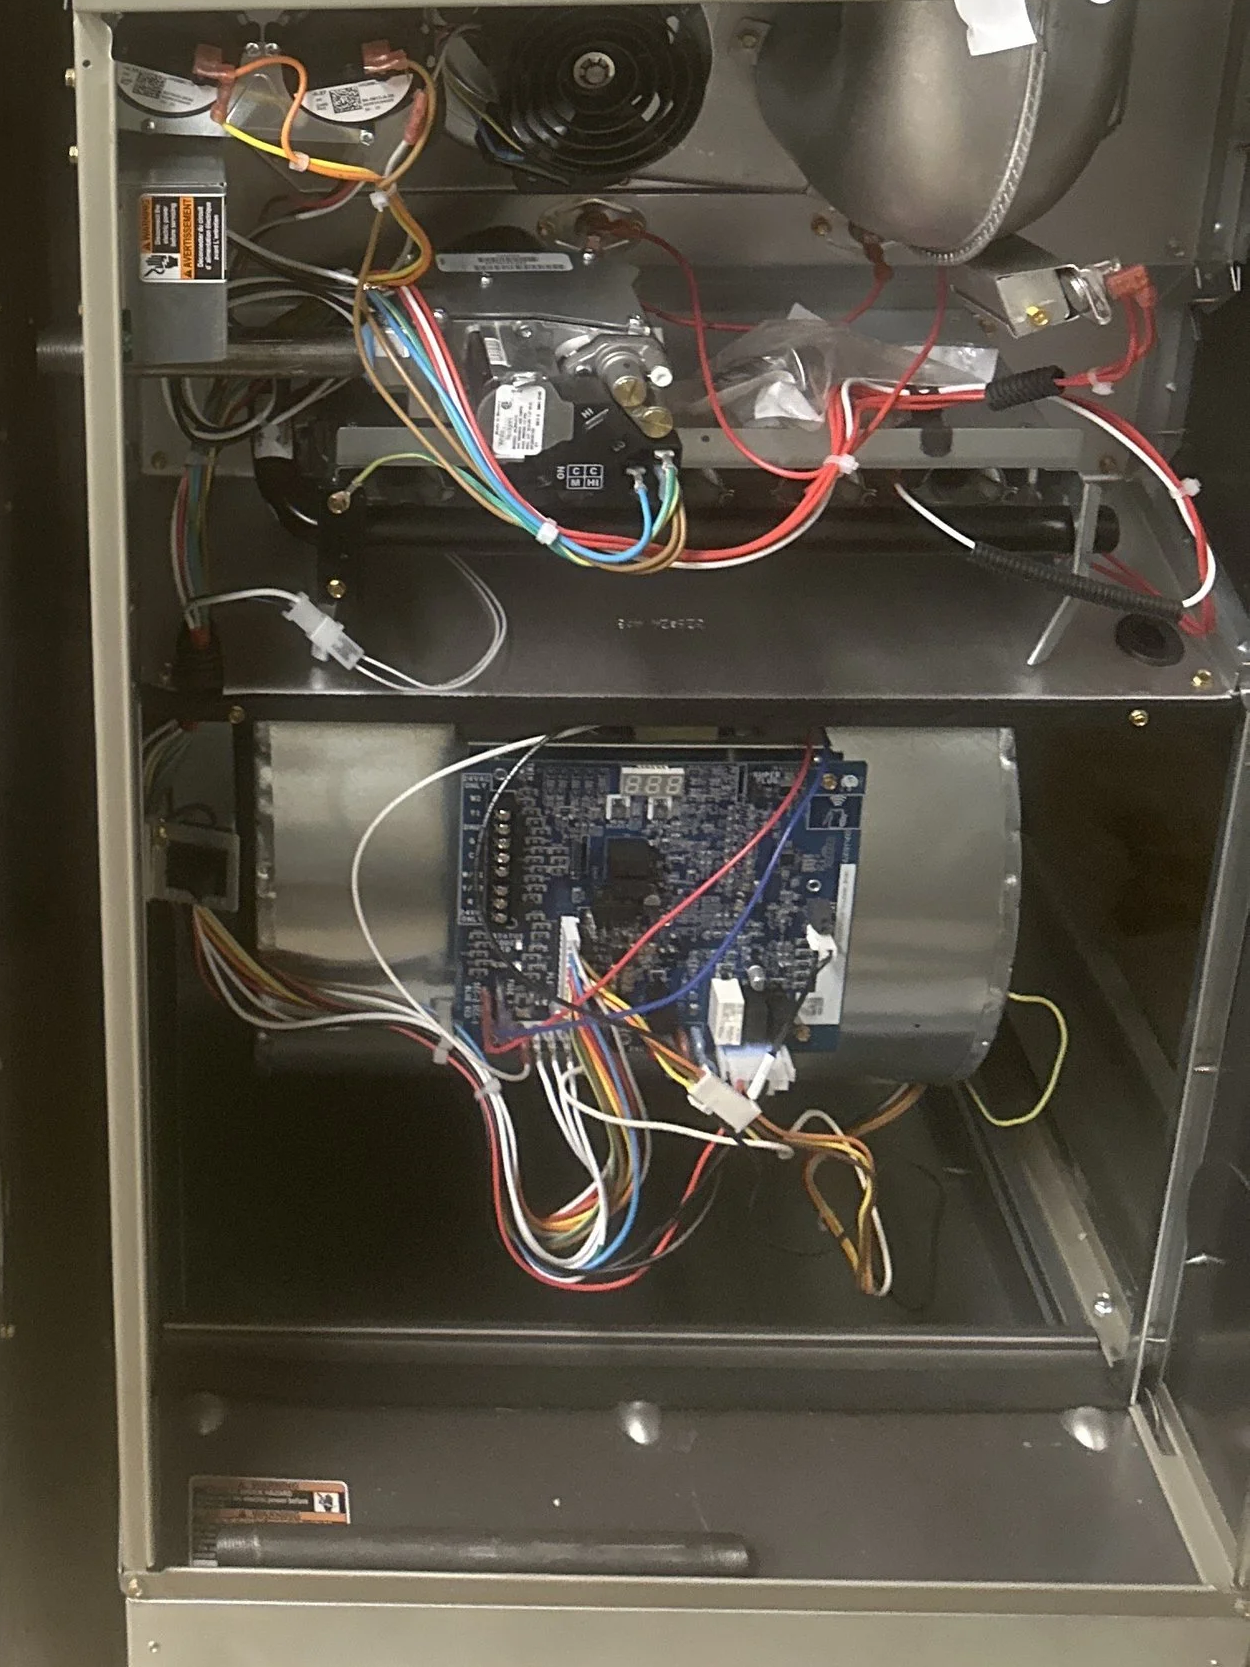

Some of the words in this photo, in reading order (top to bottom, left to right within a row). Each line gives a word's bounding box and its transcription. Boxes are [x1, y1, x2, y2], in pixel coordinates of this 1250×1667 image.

[183, 199, 192, 268] AVERTISSEMENT
[556, 465, 566, 480] ON
[572, 467, 580, 476] C
[589, 467, 598, 476] C
[587, 478, 599, 487] HI
